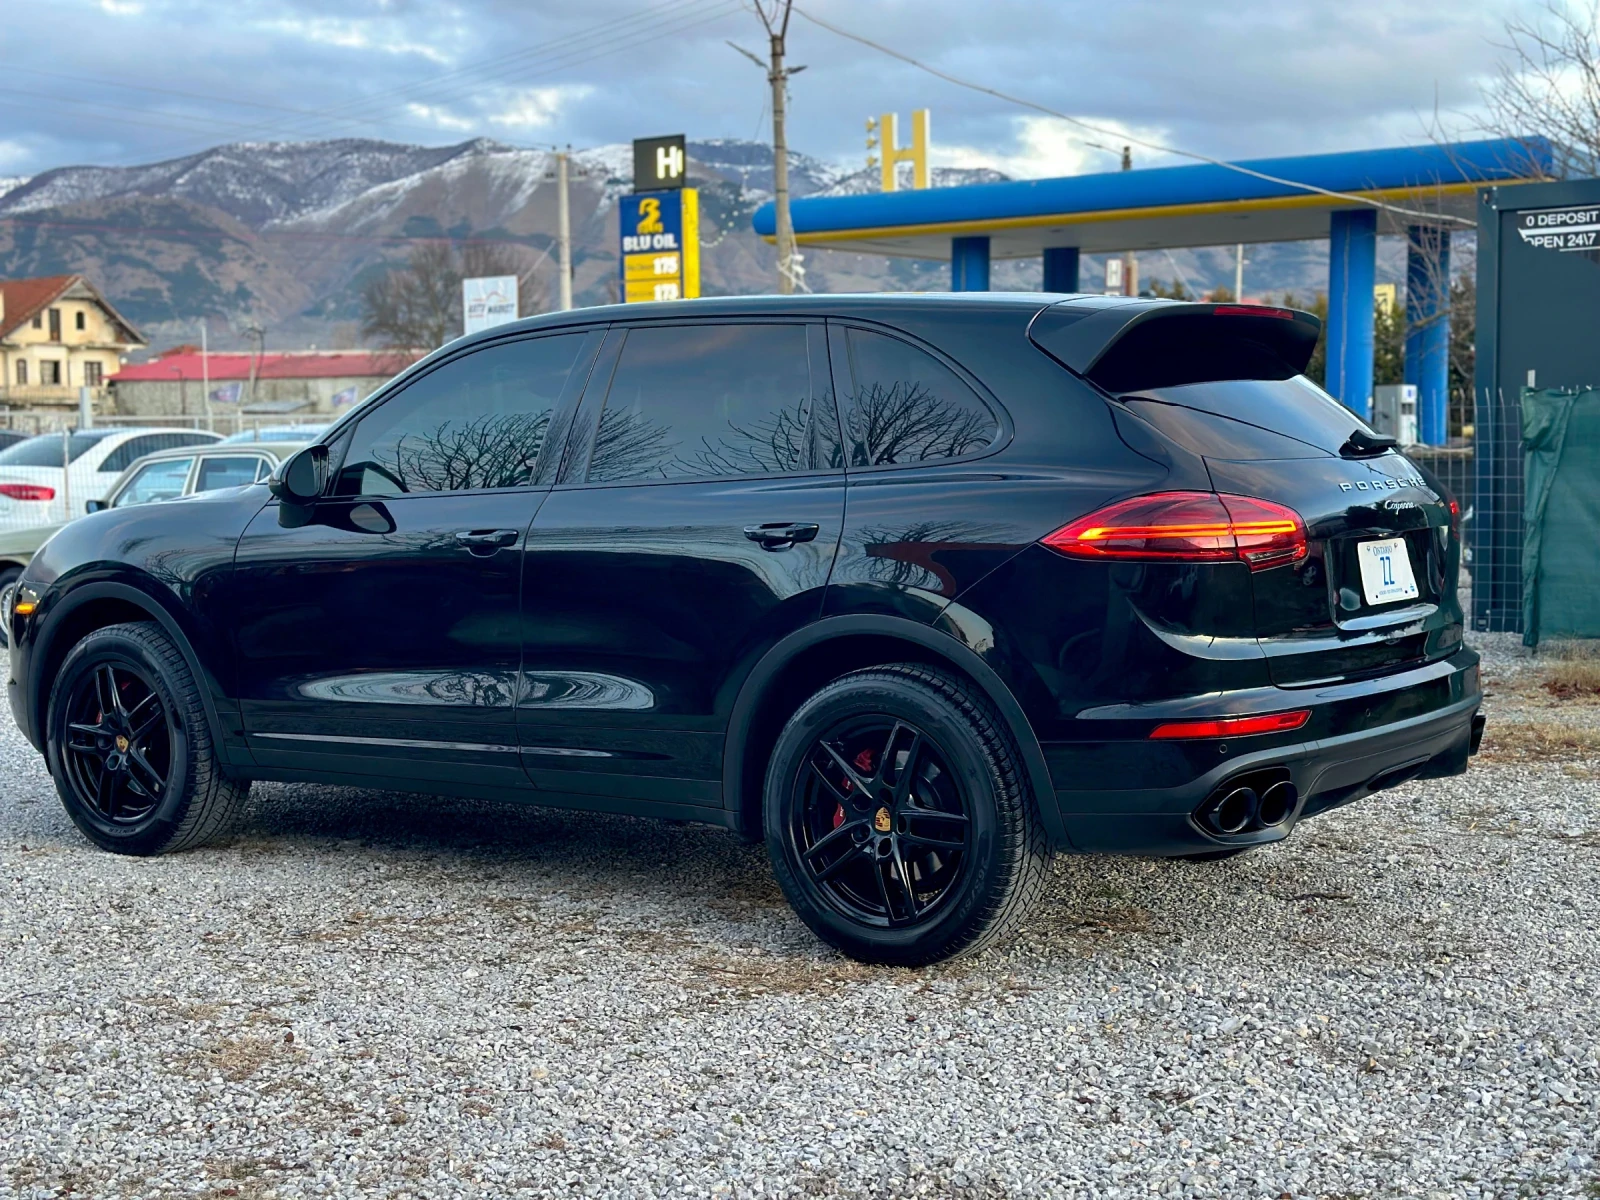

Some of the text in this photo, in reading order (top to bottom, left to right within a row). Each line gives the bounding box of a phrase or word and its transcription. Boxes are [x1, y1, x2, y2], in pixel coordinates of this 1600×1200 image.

[1526, 211, 1599, 226] 0 DEPOSIT
[623, 233, 678, 251] BLU OIL
[653, 257, 678, 275] 175
[1338, 476, 1427, 492] PORSCHE
[1384, 500, 1415, 515] Cayenne
